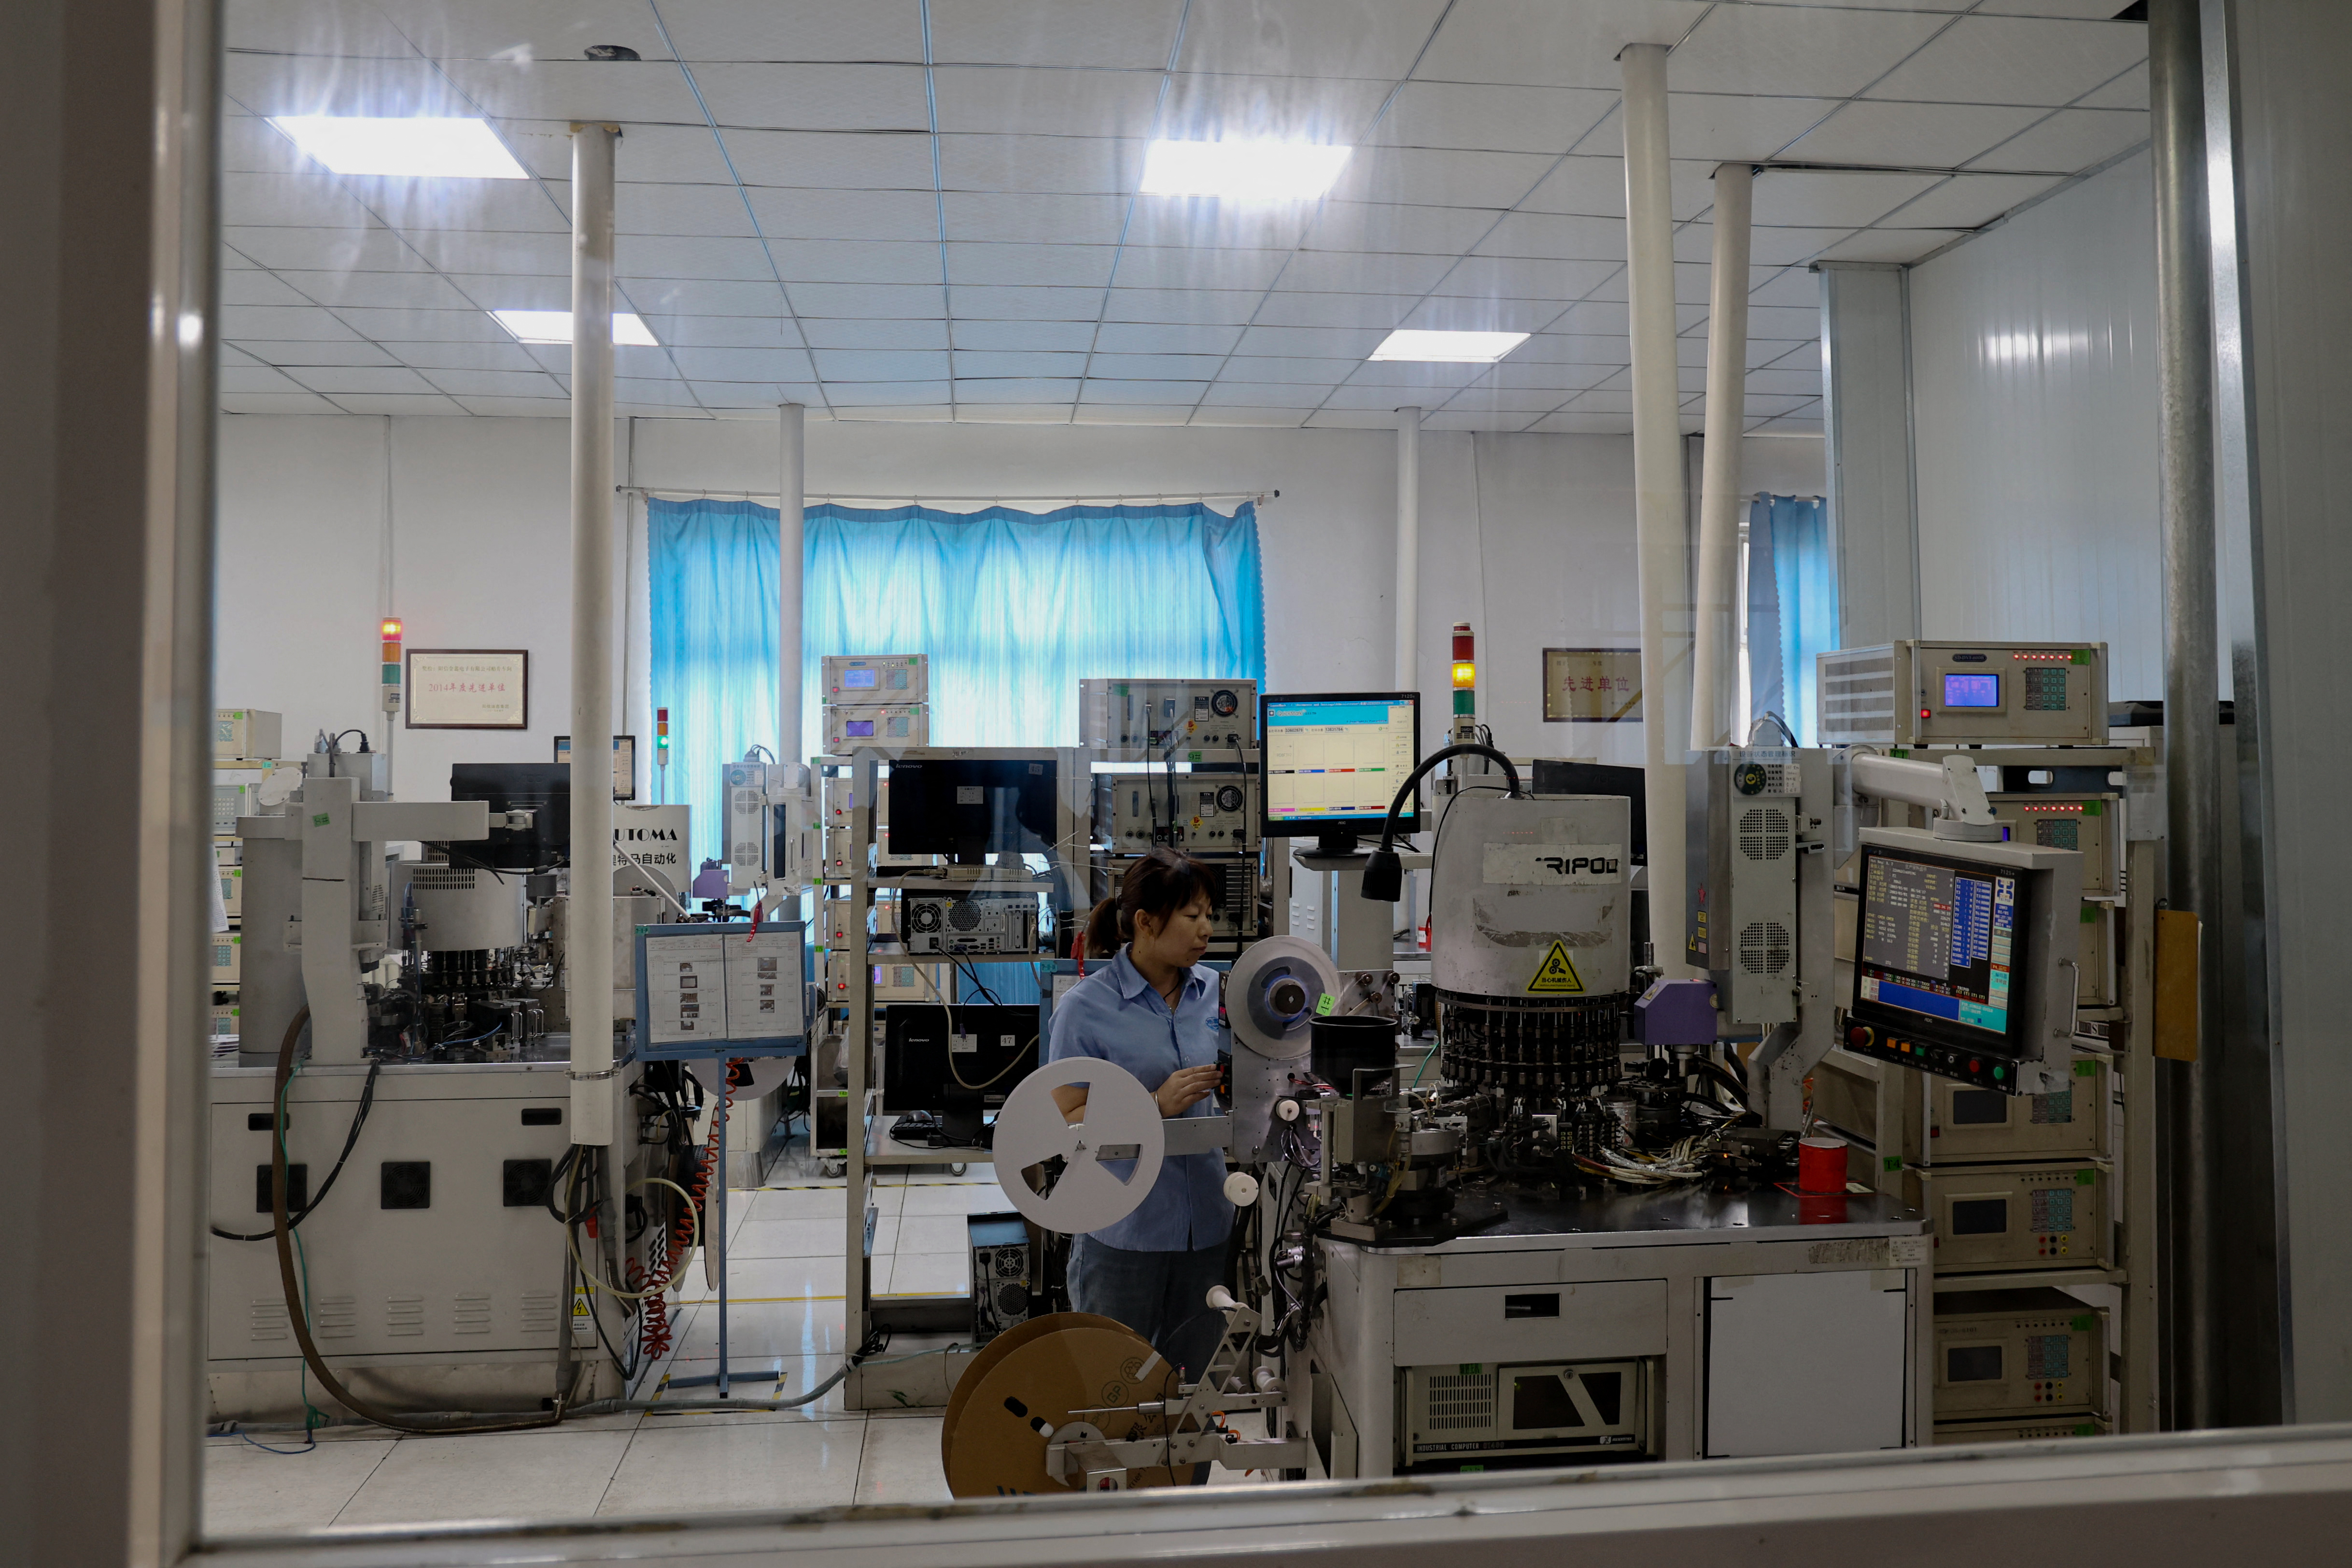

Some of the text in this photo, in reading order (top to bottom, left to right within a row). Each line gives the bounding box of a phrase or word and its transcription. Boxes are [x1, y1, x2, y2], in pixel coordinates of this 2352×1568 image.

[429, 683, 506, 692] 2014年度先进单位
[1562, 676, 1629, 692] 先进单位
[613, 829, 678, 842] UTOMA
[1884, 1160, 1901, 1169] T4
[1107, 1385, 1122, 1403] GP
[1417, 1443, 1447, 1452] INDUSTRIAL
